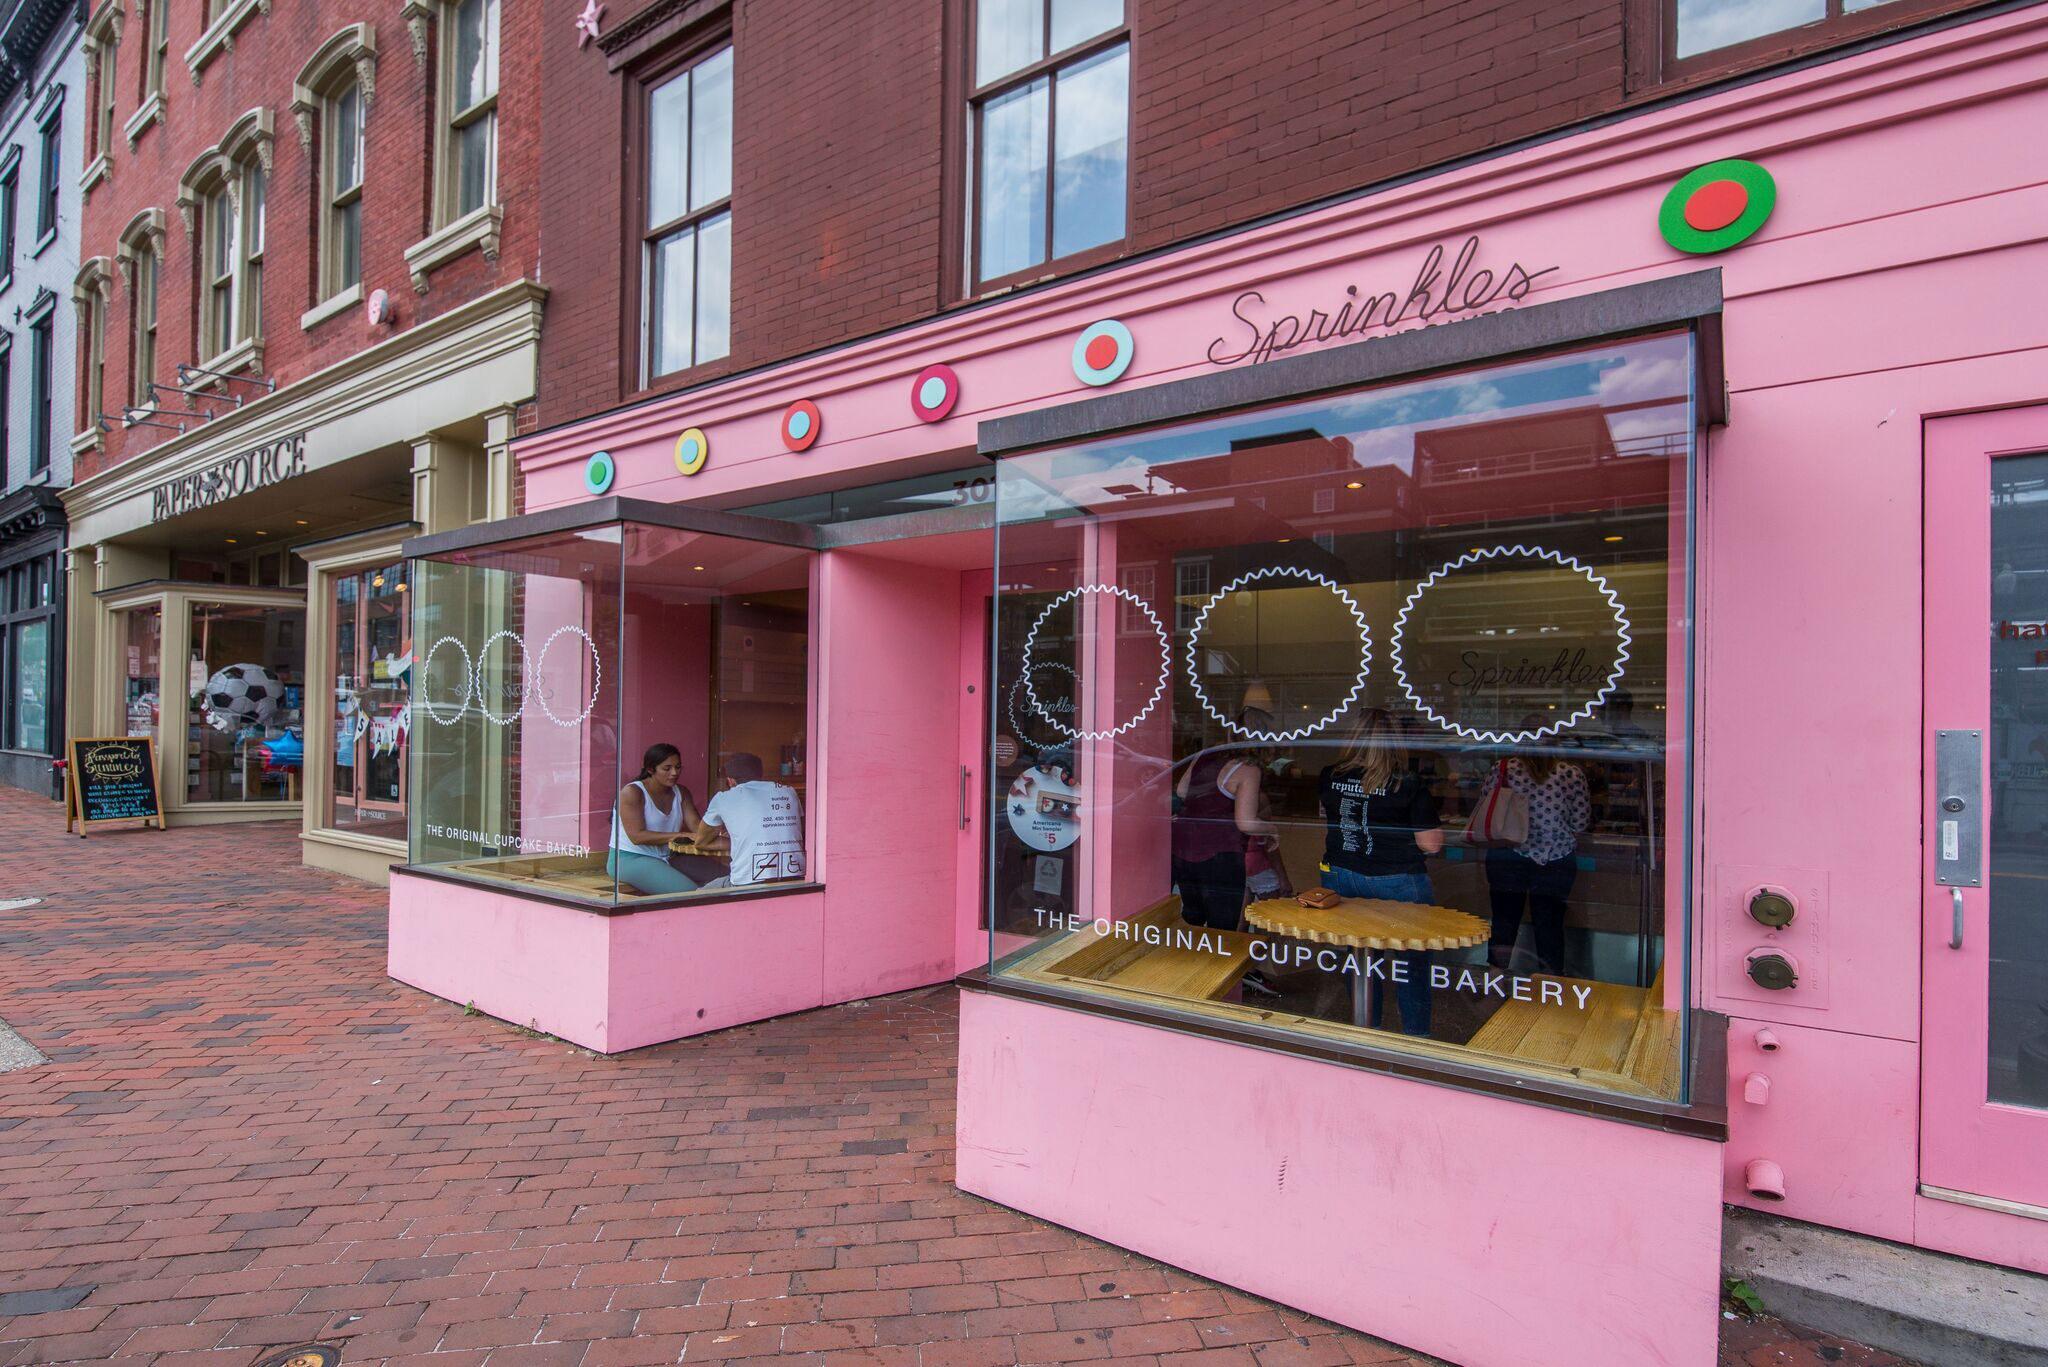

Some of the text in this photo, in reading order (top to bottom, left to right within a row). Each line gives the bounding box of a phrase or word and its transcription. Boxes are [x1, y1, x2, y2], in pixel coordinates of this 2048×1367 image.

[1208, 235, 1560, 364] Sprinkles
[152, 432, 306, 523] PAPER SOURCE
[2000, 620, 2048, 640] ha
[1448, 648, 1612, 695] Sprinkles
[1020, 696, 1080, 717] Spinkles
[1331, 781, 1387, 797] reputaon
[426, 824, 591, 859] THE ORIGINAL CUPCAKE BAKERY
[1034, 908, 1592, 1010] THE ORIGINAL CUPCAKE BAKERY
